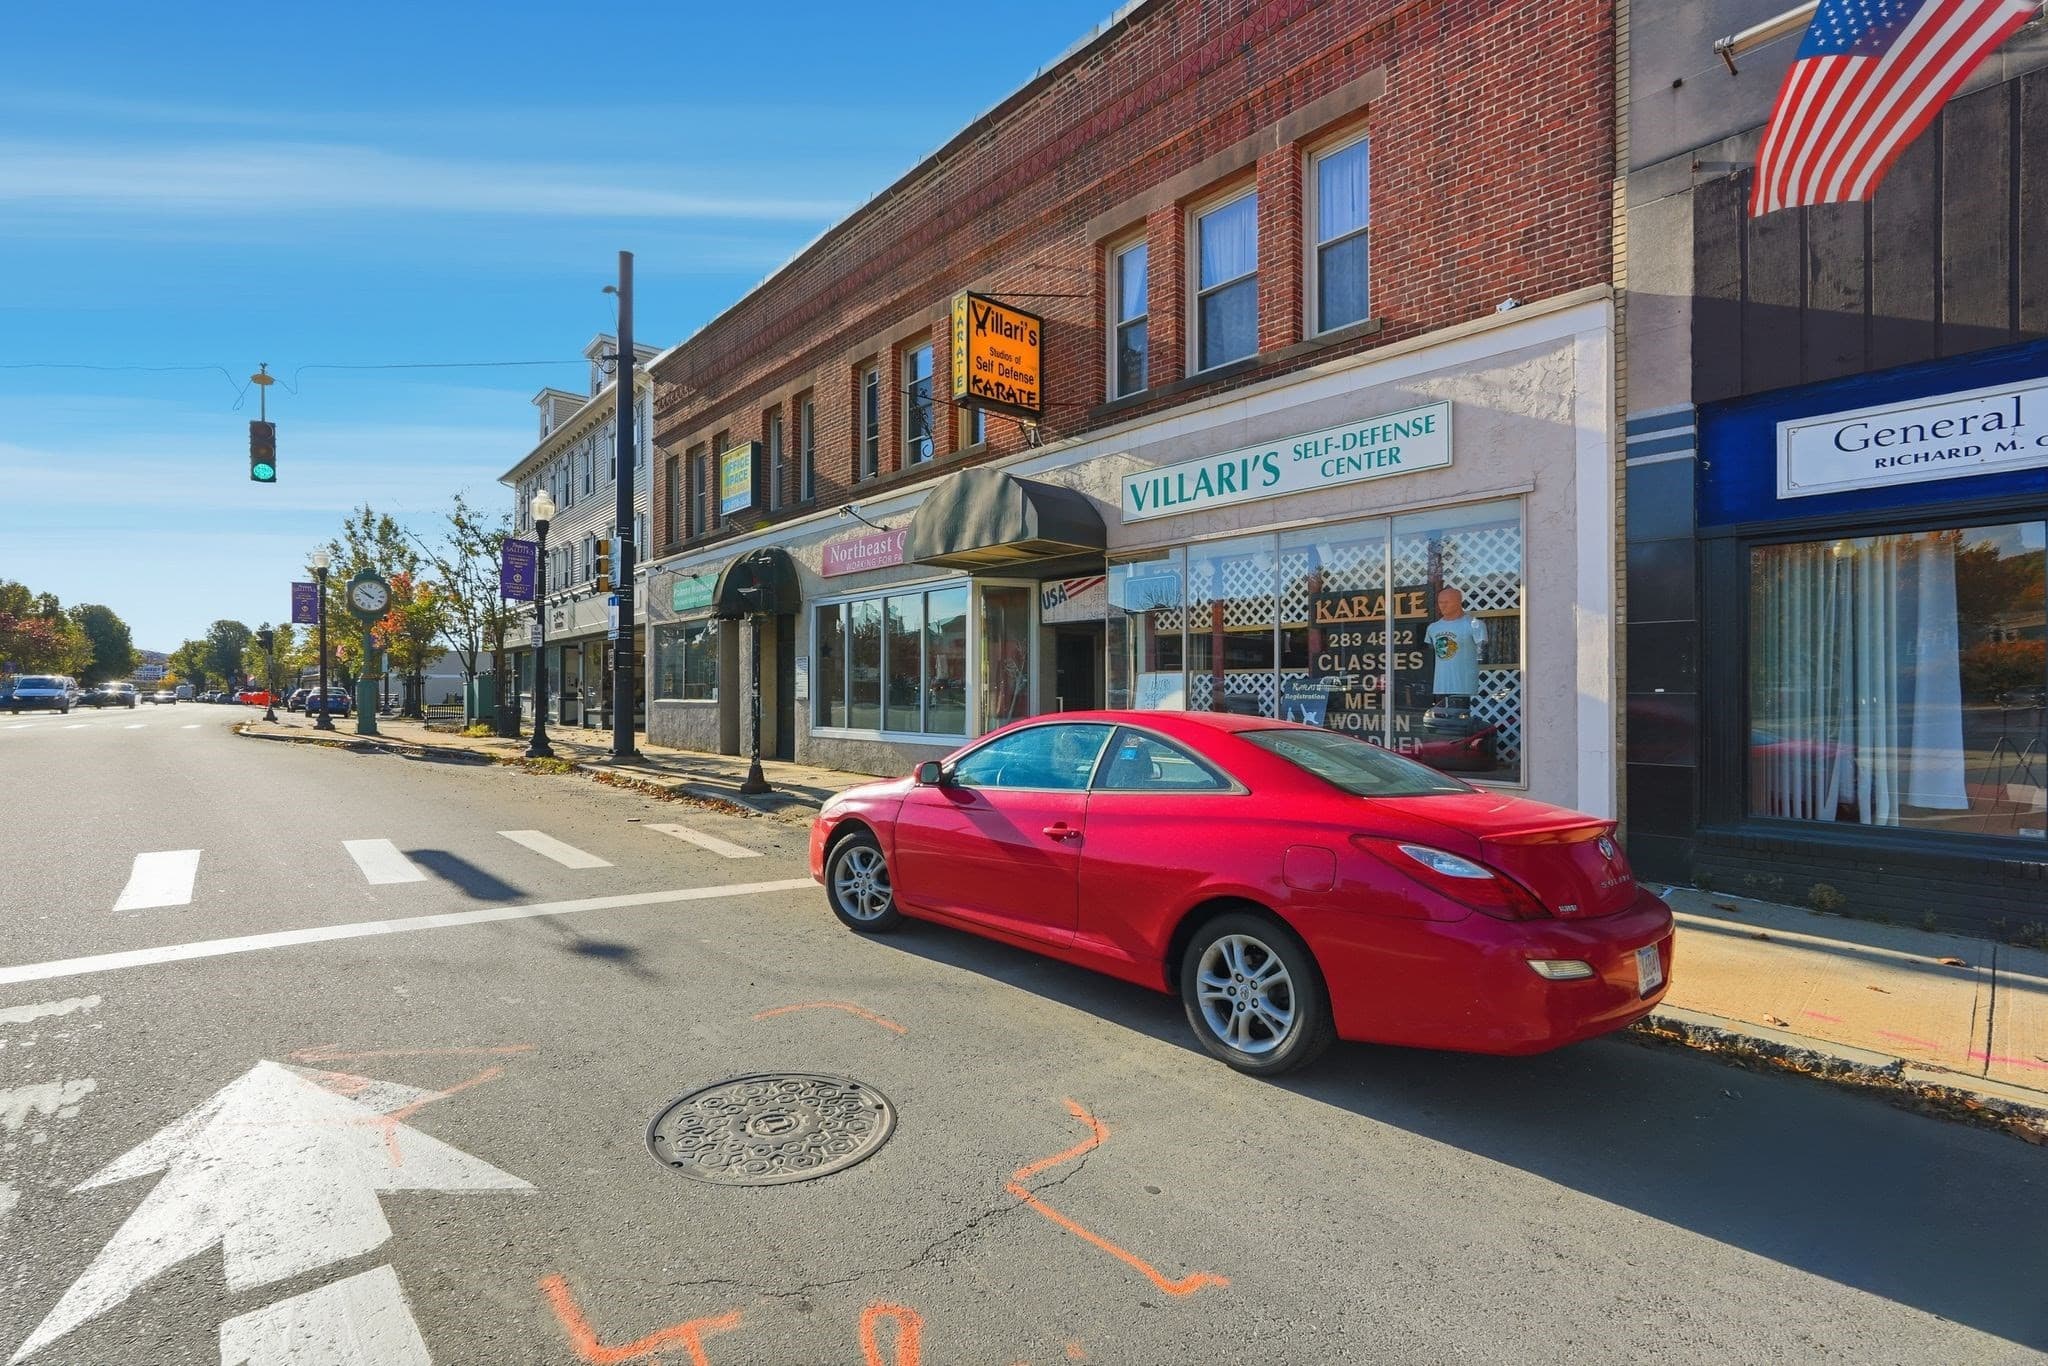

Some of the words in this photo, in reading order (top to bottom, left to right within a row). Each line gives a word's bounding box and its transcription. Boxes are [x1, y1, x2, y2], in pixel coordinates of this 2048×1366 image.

[971, 300, 1037, 346] Villari's
[956, 297, 965, 389] KARATE
[989, 346, 1012, 362] Studios
[1015, 355, 1022, 365] of
[976, 355, 994, 373] Self
[998, 362, 1035, 385] Defense
[972, 374, 1037, 408] KARATE
[1293, 414, 1436, 462] SELF-DEFENSE
[1833, 395, 2026, 453] General
[1320, 446, 1402, 478] CENTER
[1874, 444, 1982, 469] RICHARD
[1994, 439, 2025, 453] M.
[1130, 451, 1281, 512] VILLARI'S
[830, 537, 893, 563] Northeast
[1042, 584, 1068, 610] USA
[1315, 591, 1429, 623] KARATE
[1329, 633, 1362, 648] 283
[1318, 651, 1424, 671] CLASSES
